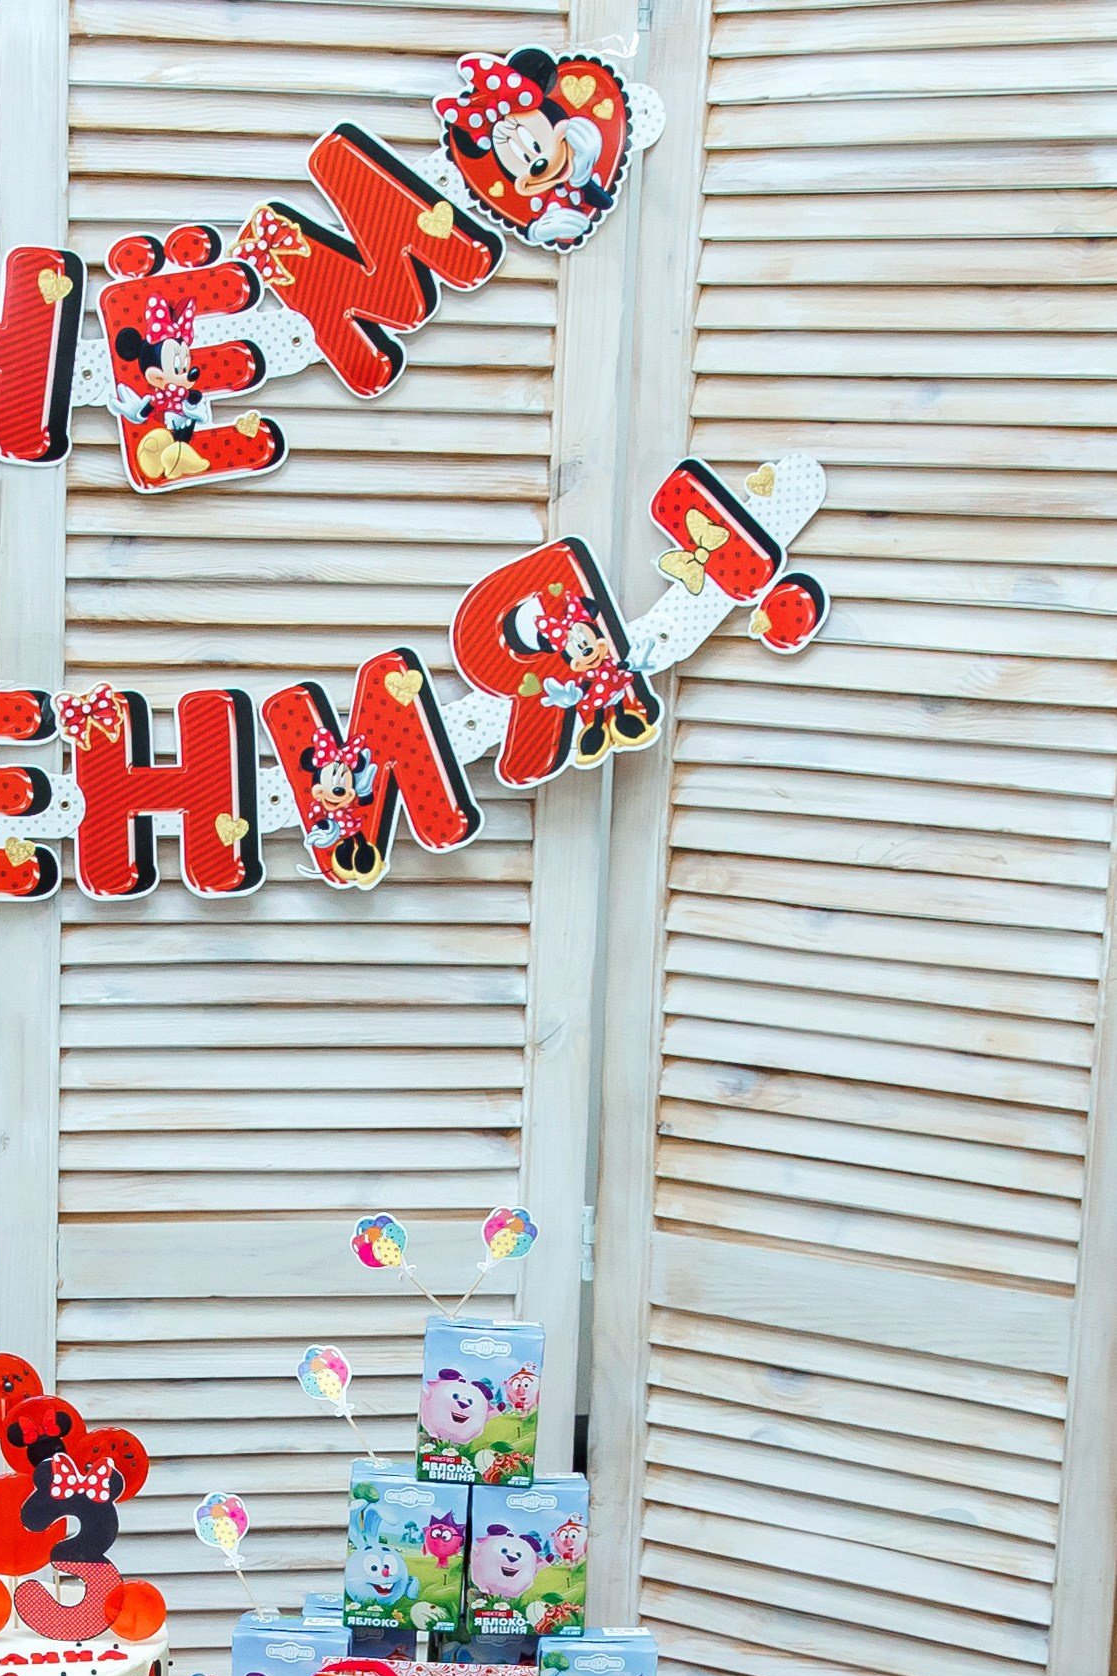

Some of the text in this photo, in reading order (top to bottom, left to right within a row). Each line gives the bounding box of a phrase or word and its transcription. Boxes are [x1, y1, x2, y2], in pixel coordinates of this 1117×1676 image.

[428, 1470, 476, 1482] ВИШНЯ
[347, 1616, 399, 1628] ЯБЛОКО
[481, 1624, 527, 1635] ВИШНЯ
